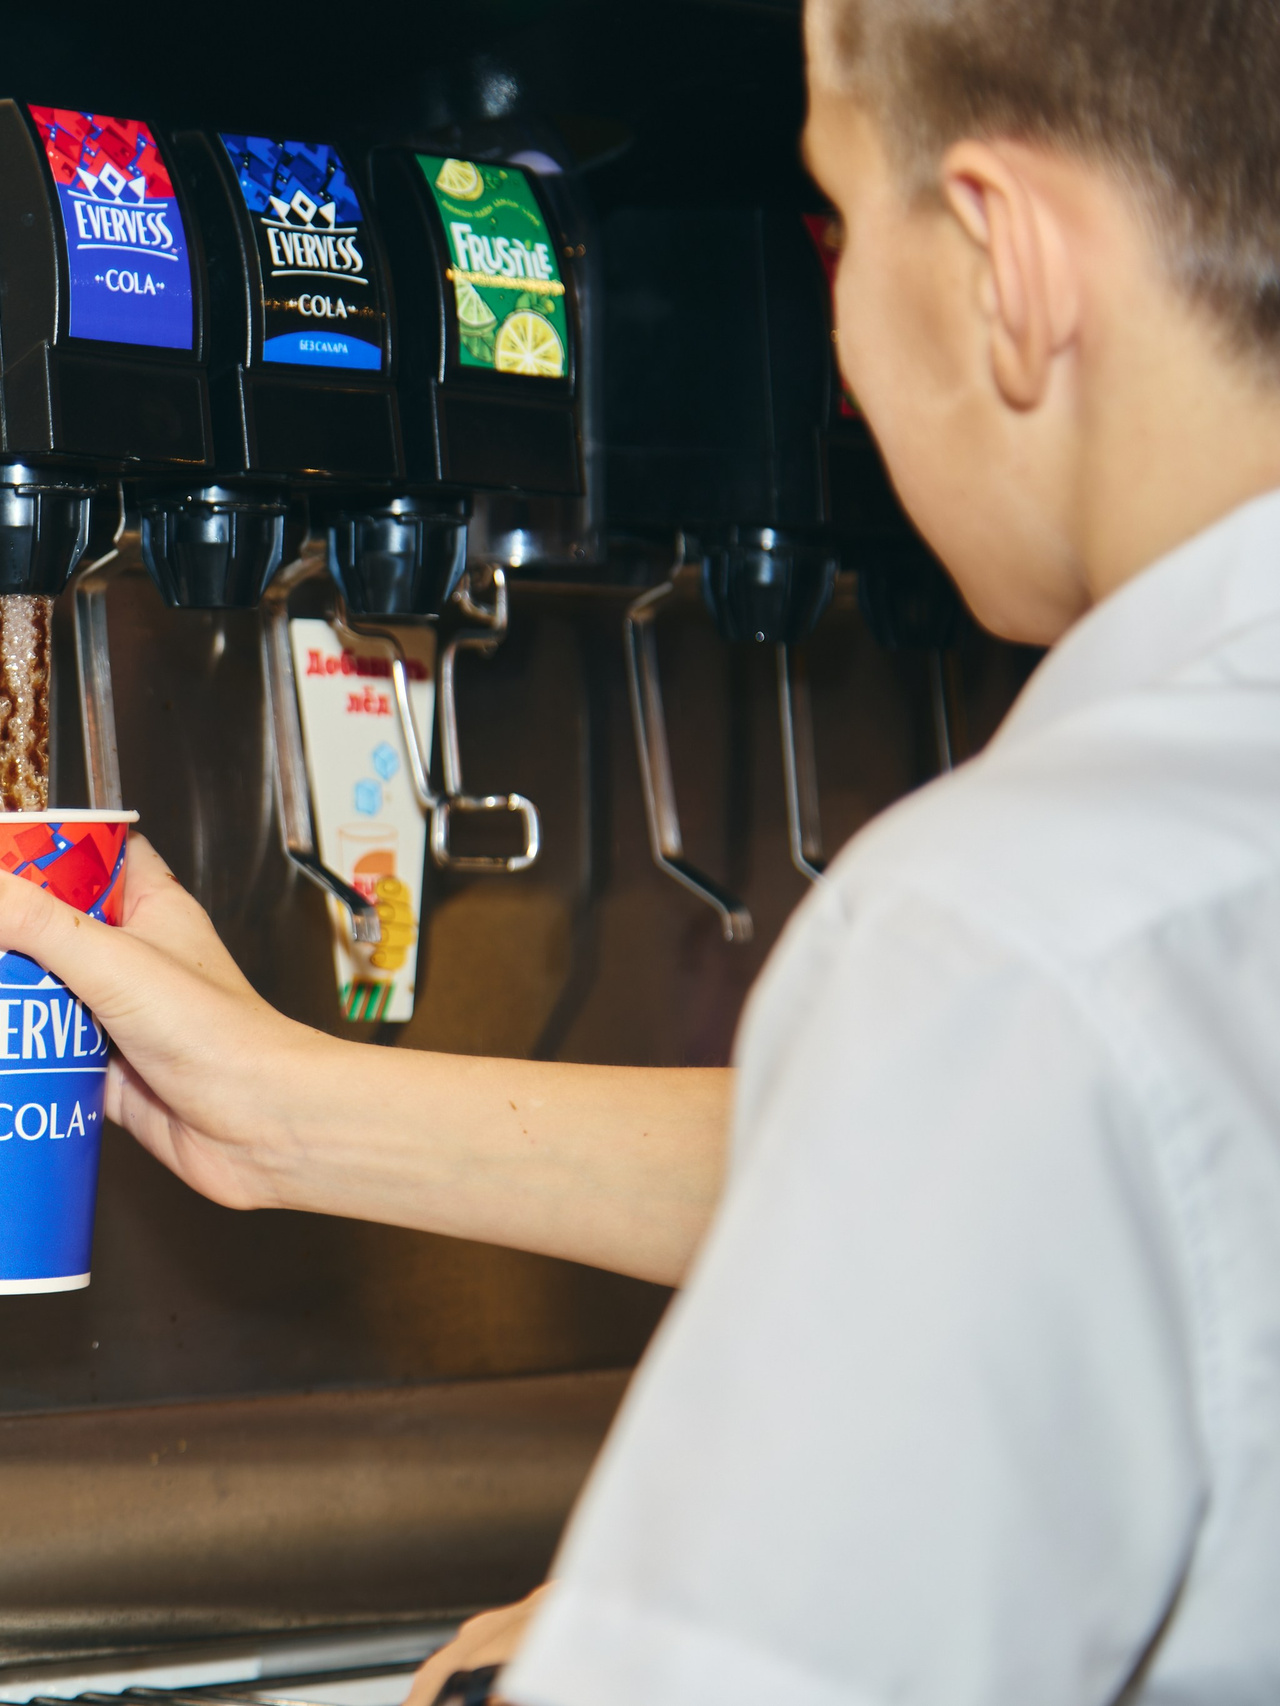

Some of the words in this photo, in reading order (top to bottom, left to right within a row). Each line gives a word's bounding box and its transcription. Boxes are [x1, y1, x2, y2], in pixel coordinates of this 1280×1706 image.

[74, 200, 173, 249] EVERVESS
[267, 227, 364, 273] EVERVESS
[105, 268, 156, 296] COLA
[298, 293, 348, 319] COLA
[299, 339, 315, 352] БЕЗ
[316, 341, 349, 354] САХАРА
[346, 685, 391, 716] лёд
